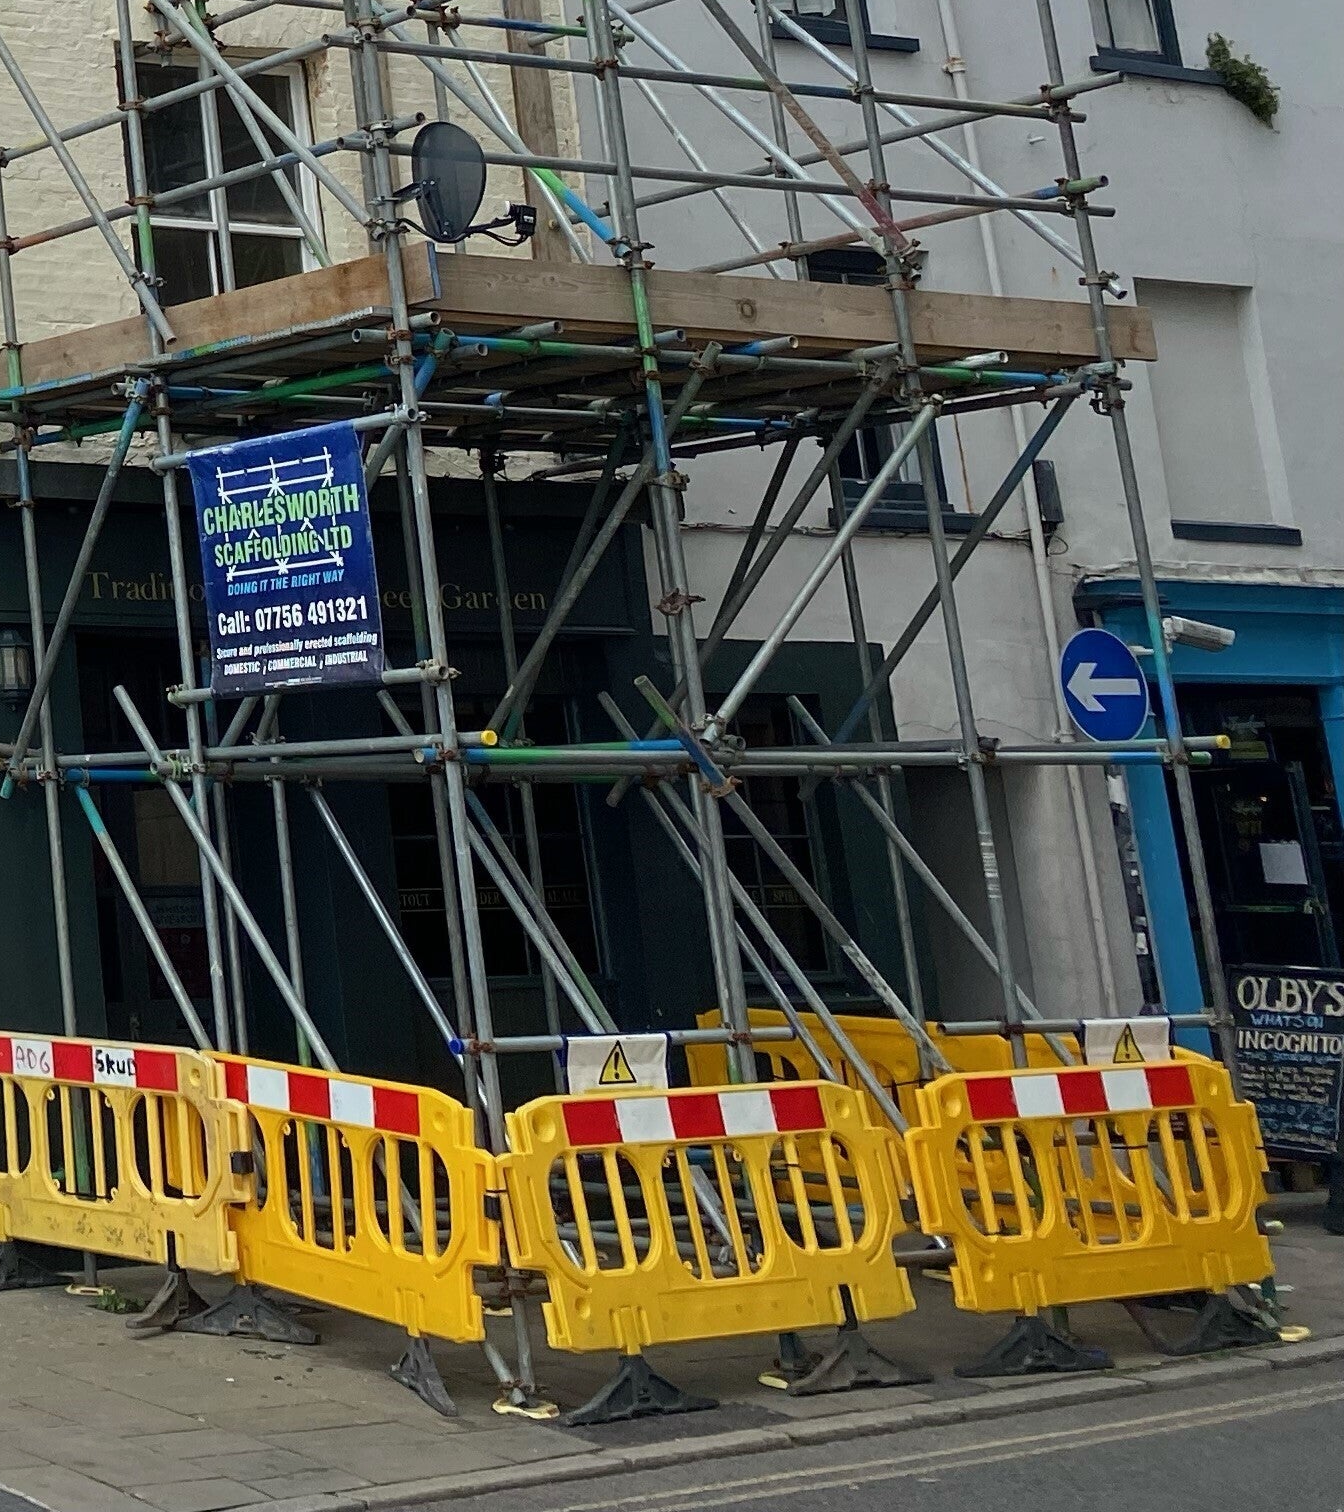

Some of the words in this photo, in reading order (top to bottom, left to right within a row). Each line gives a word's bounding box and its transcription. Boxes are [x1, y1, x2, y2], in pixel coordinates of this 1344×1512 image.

[203, 483, 361, 536] CHARLESWORTH
[214, 529, 319, 567] SCAFFOLDING
[323, 524, 353, 551] LTD
[227, 581, 258, 596] DOING
[259, 580, 269, 593] IT
[270, 577, 289, 590] THE
[291, 573, 321, 588] RIGHT
[323, 569, 346, 584] WAY
[438, 582, 548, 611] Garen
[217, 610, 251, 636] Call:
[254, 602, 303, 630] 07756
[307, 595, 368, 626] 491321
[223, 661, 261, 676] DOMESTIC
[268, 656, 317, 672] COMMERCIAL
[324, 650, 368, 666] INDUSTRIAL
[239, 643, 253, 656] and
[1238, 1029, 1342, 1055] INCOGNITO
